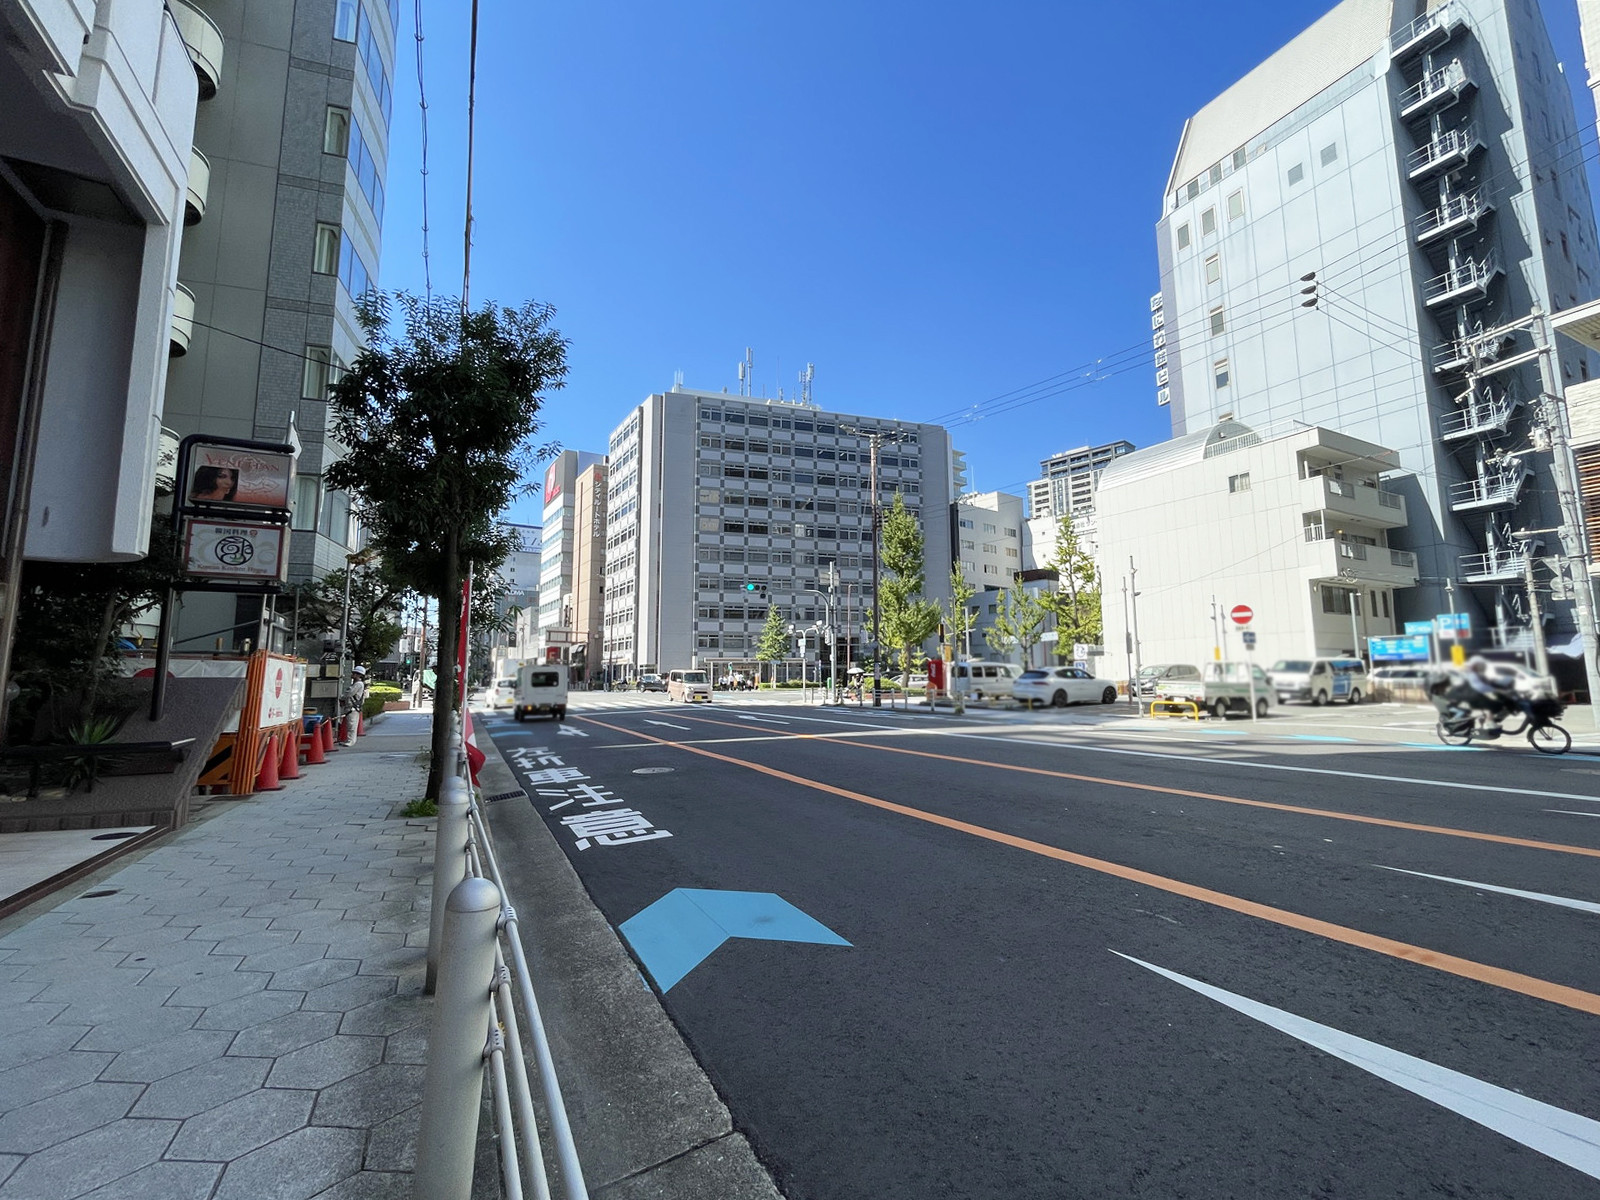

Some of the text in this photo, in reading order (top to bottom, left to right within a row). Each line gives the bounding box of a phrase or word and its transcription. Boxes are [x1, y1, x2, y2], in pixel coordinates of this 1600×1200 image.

[506, 746, 674, 851] 左折車注意
